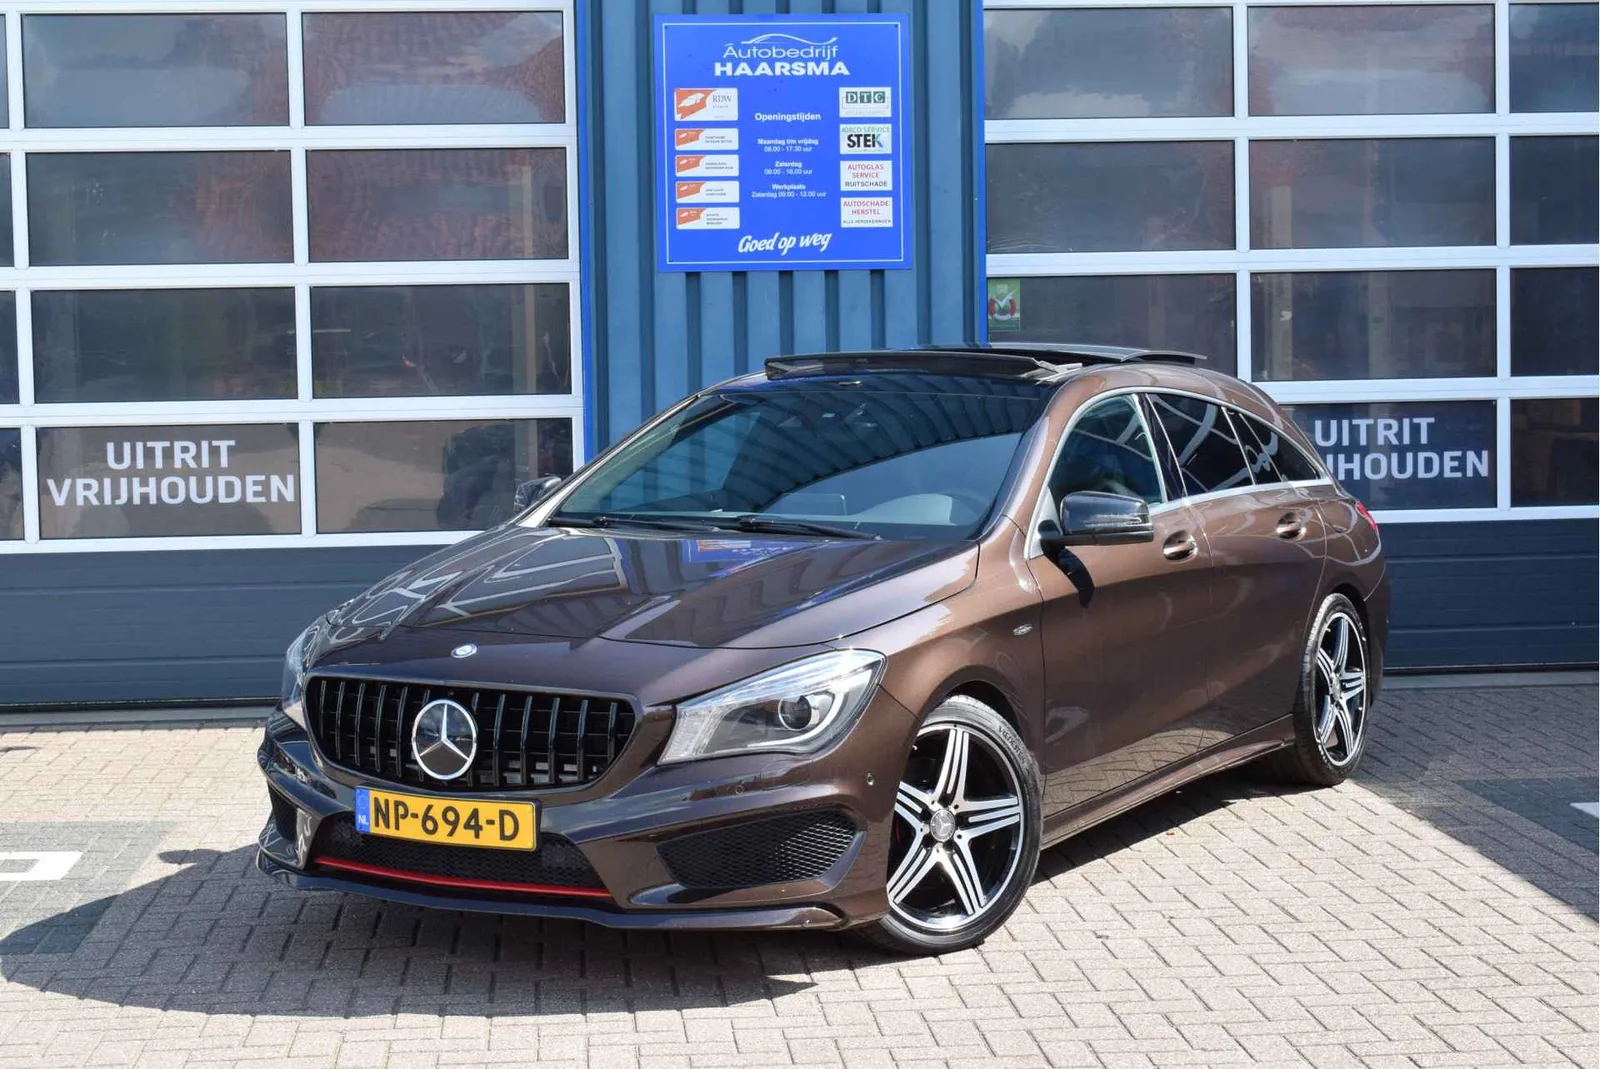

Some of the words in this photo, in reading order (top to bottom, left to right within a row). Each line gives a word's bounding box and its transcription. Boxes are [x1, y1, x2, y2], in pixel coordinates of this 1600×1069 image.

[723, 45, 839, 61] Autobedrijf
[714, 62, 850, 76] HAARSMA
[846, 91, 885, 104] DTC
[754, 112, 822, 123] Openingstijden
[757, 138, 786, 146] Maandag
[798, 138, 819, 146] vrijdag
[847, 133, 883, 148] STEK
[738, 232, 780, 253] Goed
[777, 236, 796, 256] op
[799, 232, 832, 252] weg
[1314, 417, 1435, 447] UITRIT
[106, 440, 236, 470] UITRIT
[47, 474, 295, 507] VRIJHOUDEN
[358, 814, 369, 826] NL
[373, 796, 520, 842] NP-694-D
